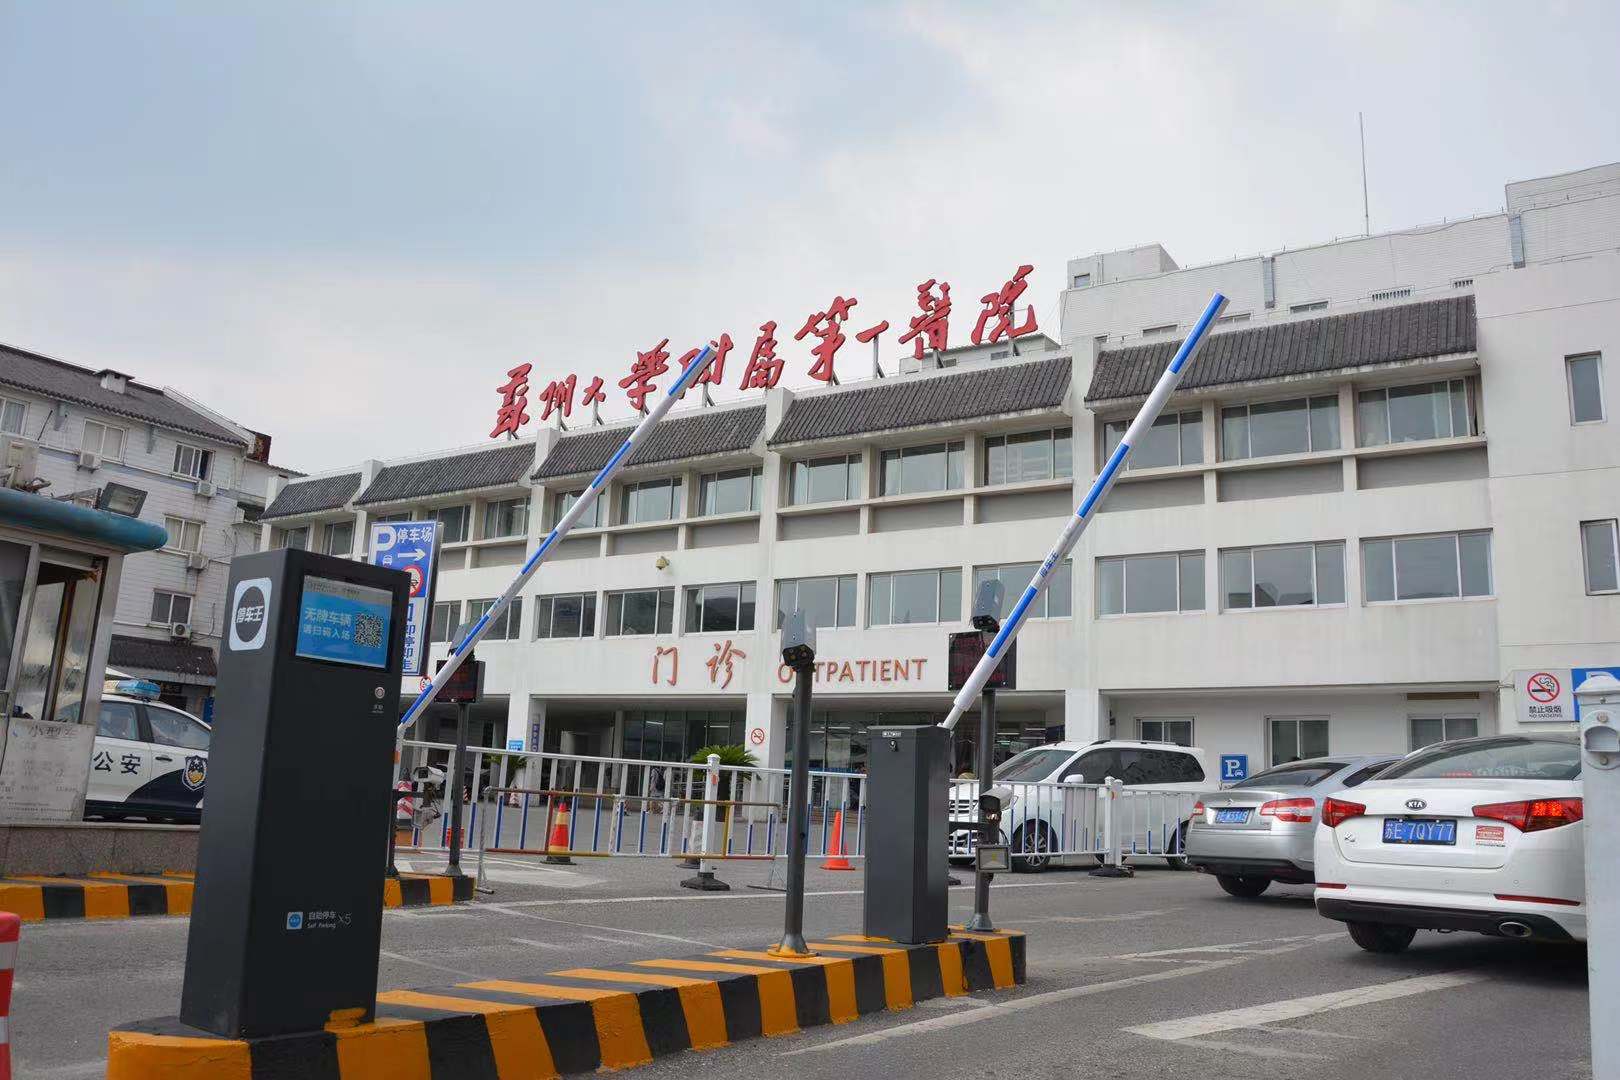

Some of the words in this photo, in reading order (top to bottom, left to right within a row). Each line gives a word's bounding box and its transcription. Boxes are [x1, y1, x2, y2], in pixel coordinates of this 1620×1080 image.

[397, 527, 432, 543] 停车场
[369, 526, 397, 565] P
[305, 607, 352, 627] 无牌车辆
[652, 640, 746, 689] 门诊
[778, 658, 928, 684] OTPATIENT
[1529, 705, 1562, 714] 禁止吸烟
[93, 751, 141, 775] 公安
[1225, 760, 1240, 777] P
[1407, 800, 1425, 809] KIA
